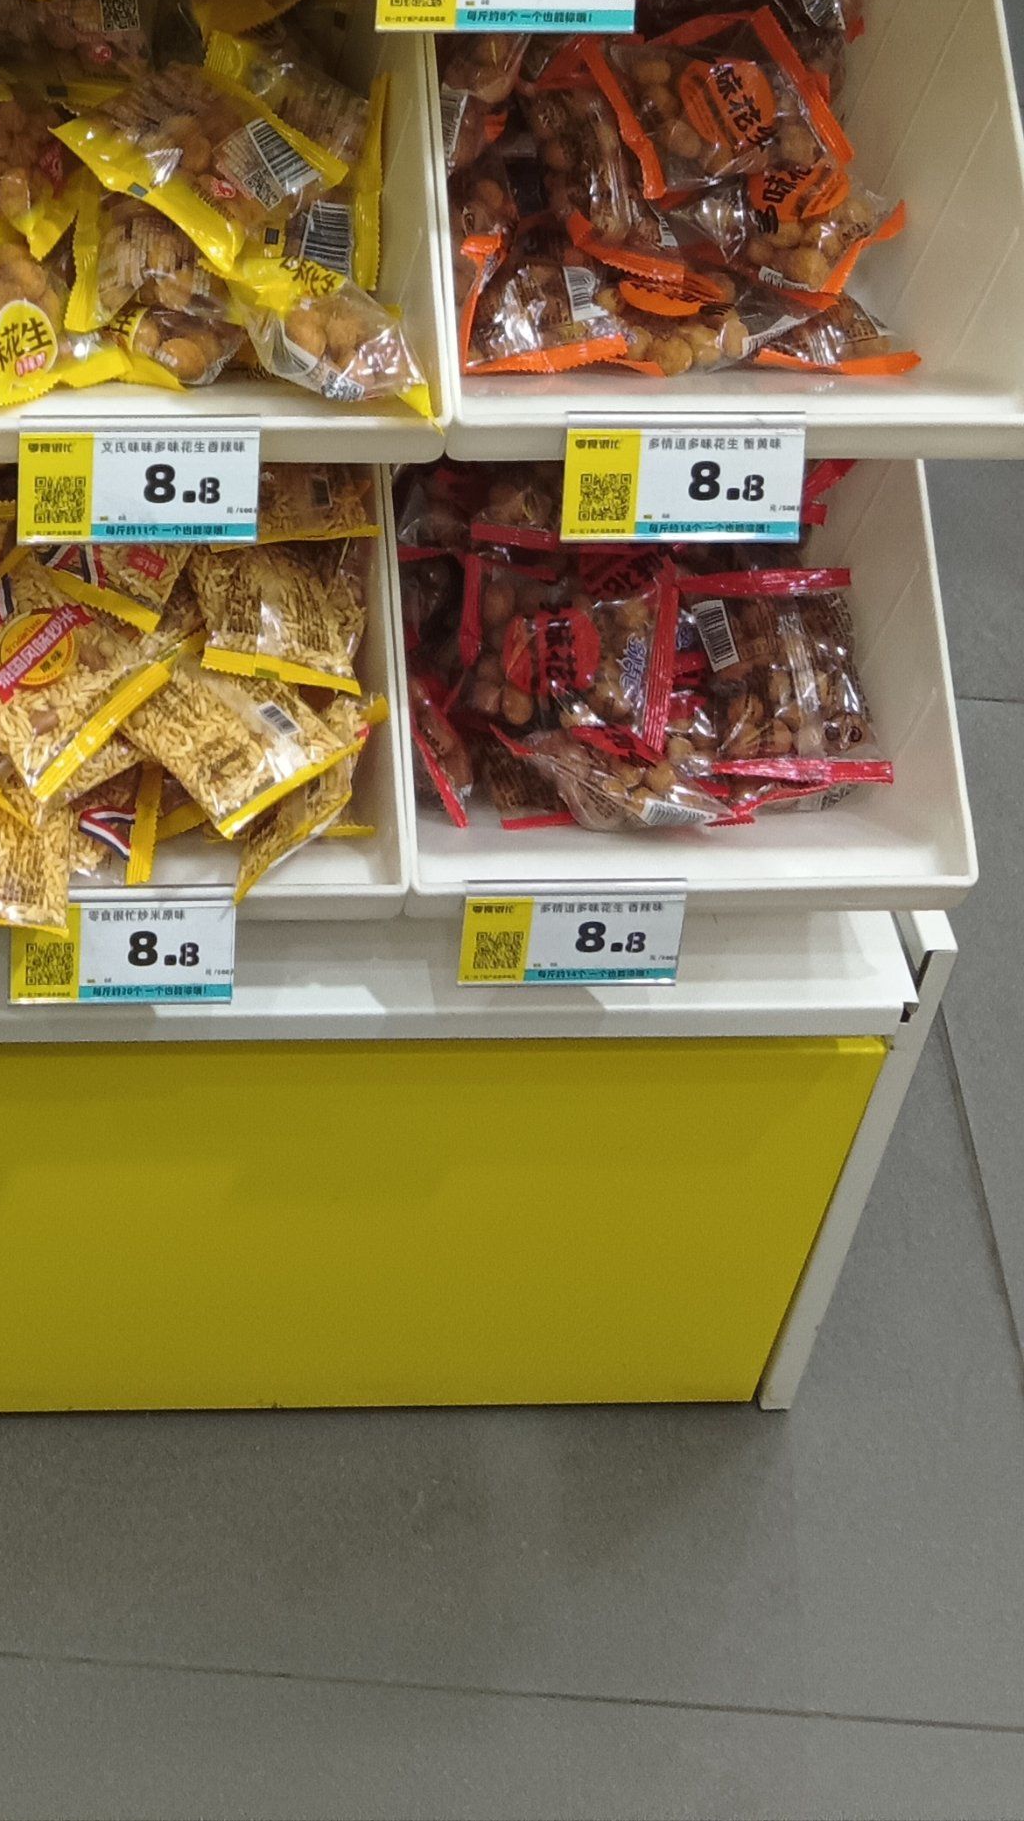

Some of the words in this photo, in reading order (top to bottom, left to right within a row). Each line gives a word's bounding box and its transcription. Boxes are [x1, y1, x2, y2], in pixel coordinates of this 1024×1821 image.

[143, 463, 221, 505] 8.8
[688, 460, 765, 502] 8.8
[127, 930, 200, 967] 8.8
[575, 920, 646, 953] 8.8
